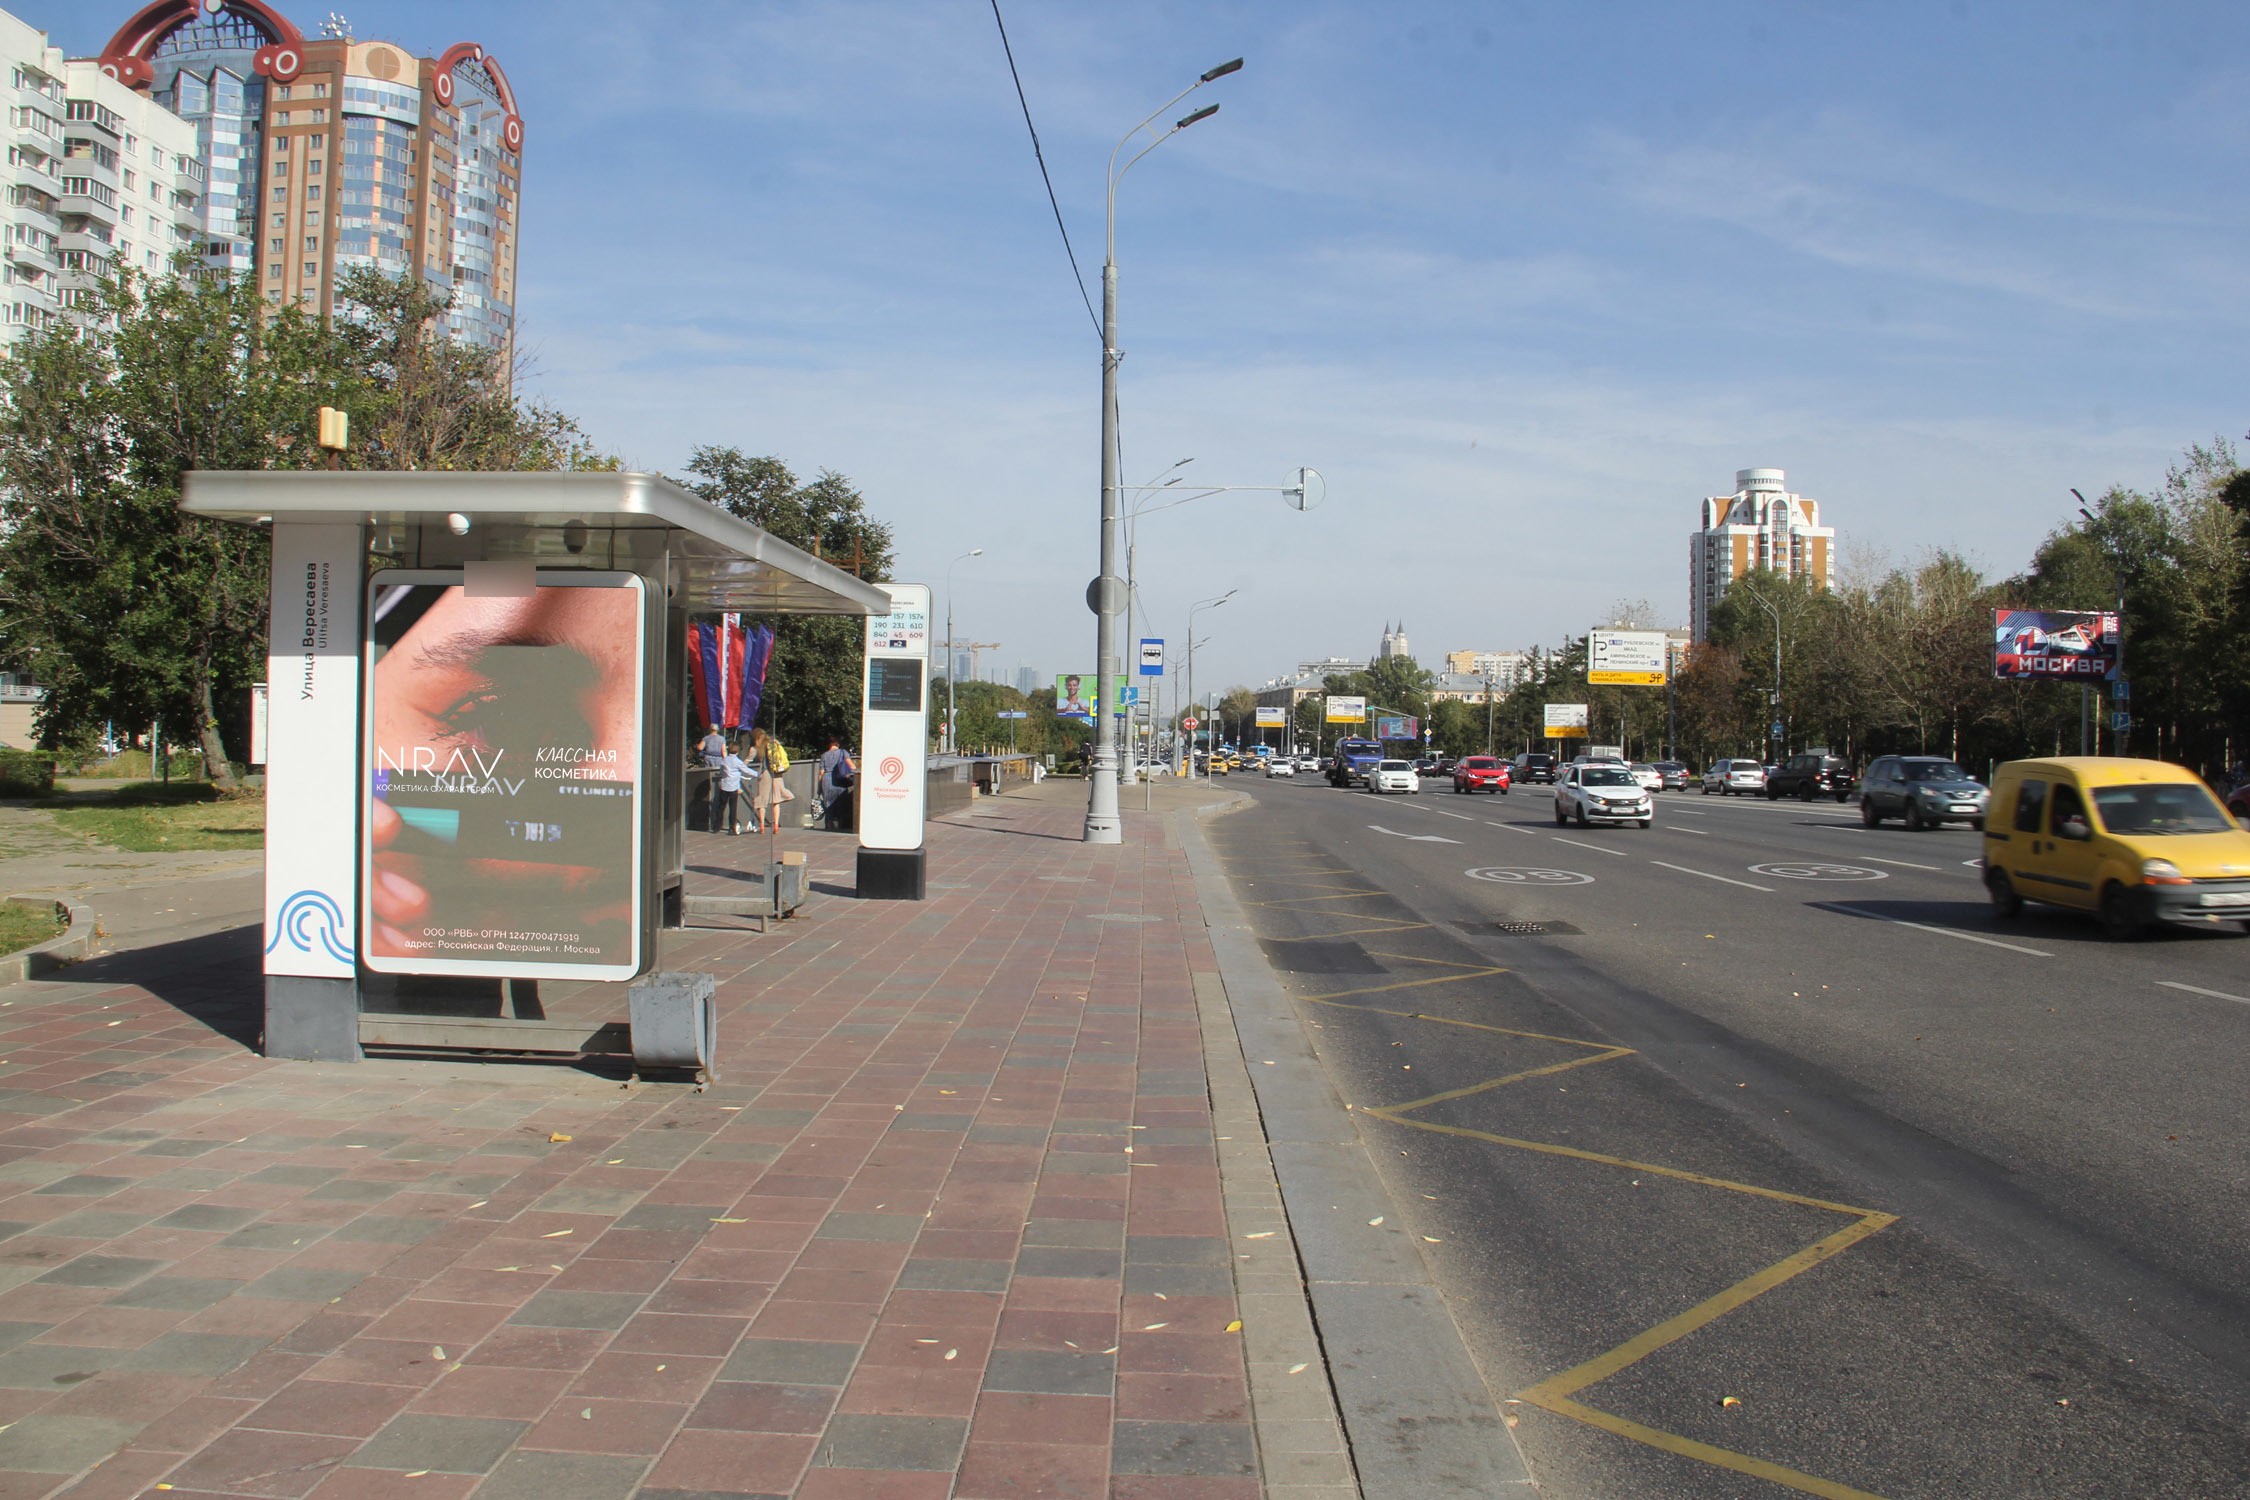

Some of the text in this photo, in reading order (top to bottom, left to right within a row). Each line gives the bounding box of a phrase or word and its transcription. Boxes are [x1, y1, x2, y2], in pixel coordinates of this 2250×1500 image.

[318, 562, 330, 648] Ulitsa Veresaeva
[301, 562, 317, 700] Улица Вересаева
[2018, 656, 2105, 673] МОСКВА
[377, 745, 504, 779] NRAV
[535, 747, 618, 763] КЛАССНАЯ
[534, 767, 618, 781] КОСМЕТИКА
[376, 783, 429, 794] КОСМЕТИКА
[436, 774, 526, 796] NRAV
[559, 785, 579, 795] EYE
[582, 787, 615, 796] LINER
[423, 928, 446, 937] ООО
[480, 929, 507, 939] ОГРН
[404, 940, 436, 950] адрес:
[438, 940, 494, 951] Российская
[564, 944, 600, 954] Москва
